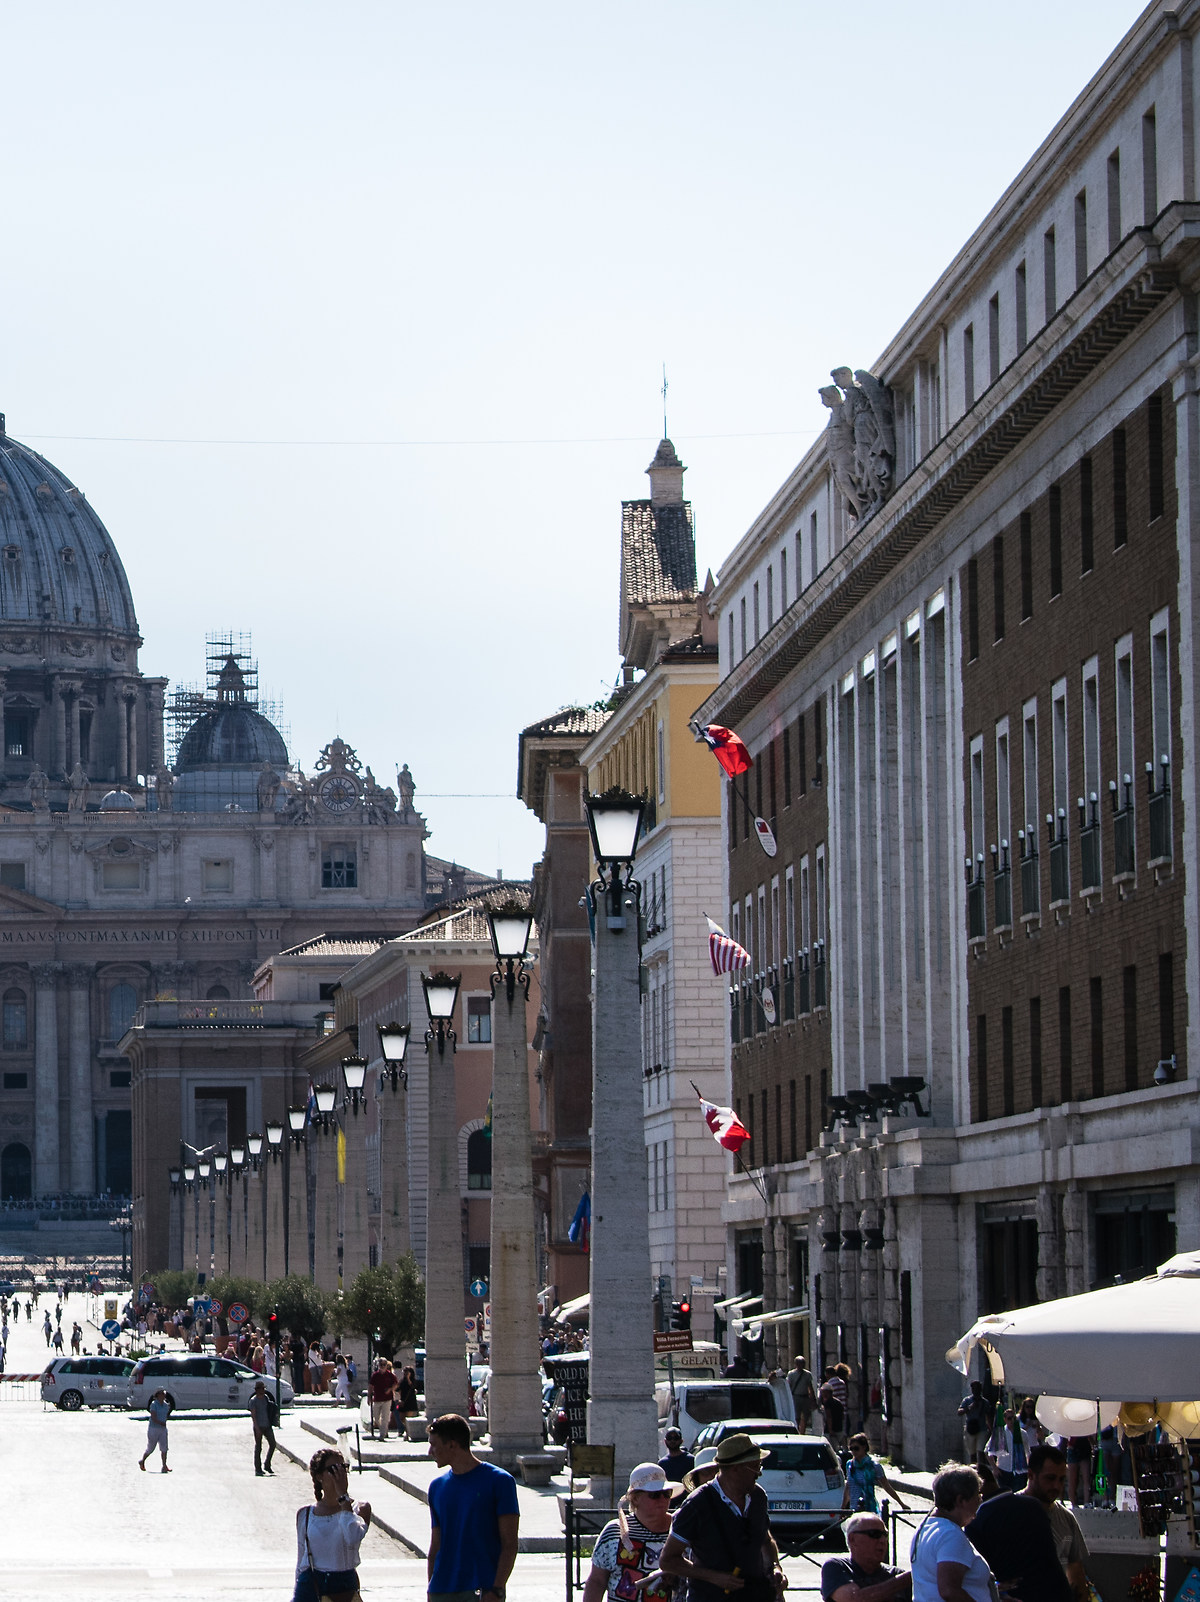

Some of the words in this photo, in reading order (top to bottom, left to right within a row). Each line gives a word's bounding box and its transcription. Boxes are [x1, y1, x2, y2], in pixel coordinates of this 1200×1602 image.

[681, 1355, 718, 1366] GELATI
[554, 1368, 577, 1381] COLD
[567, 1389, 582, 1402] ICE
